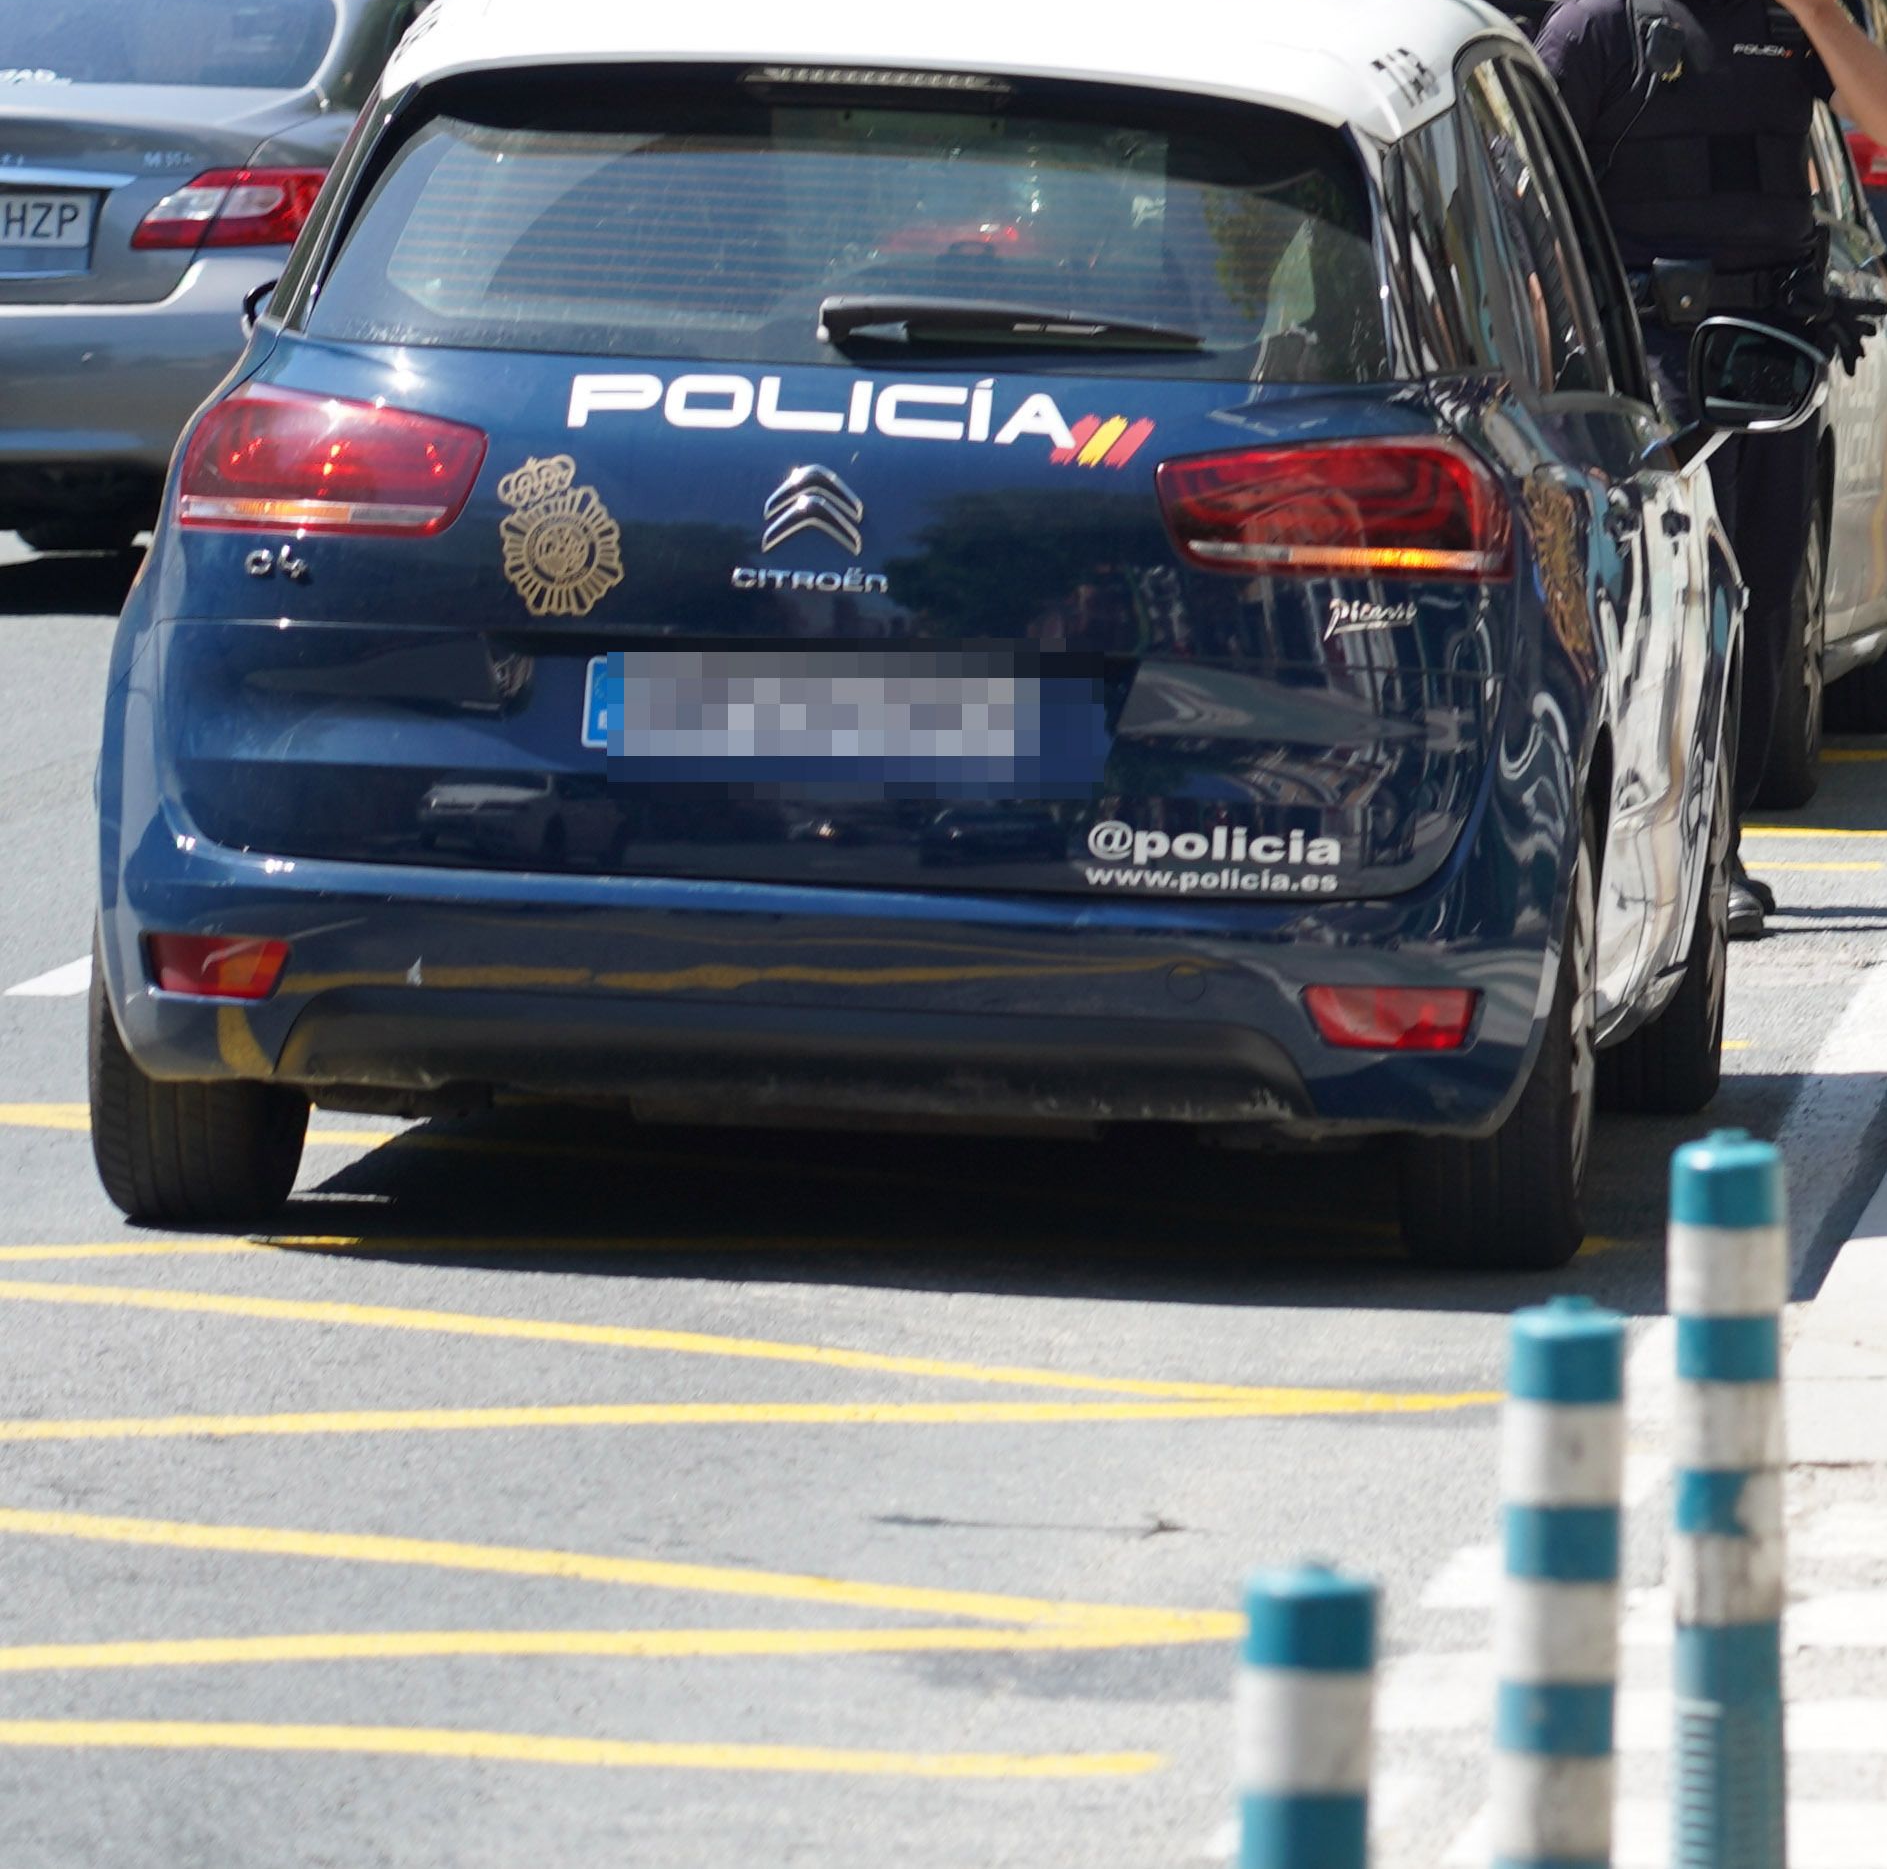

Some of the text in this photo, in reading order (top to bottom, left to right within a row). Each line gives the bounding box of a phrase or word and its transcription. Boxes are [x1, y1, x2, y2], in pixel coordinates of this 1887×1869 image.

[3, 201, 80, 239] HZP
[1087, 820, 1342, 866] @policia
[1084, 866, 1339, 893] www.policia.es
